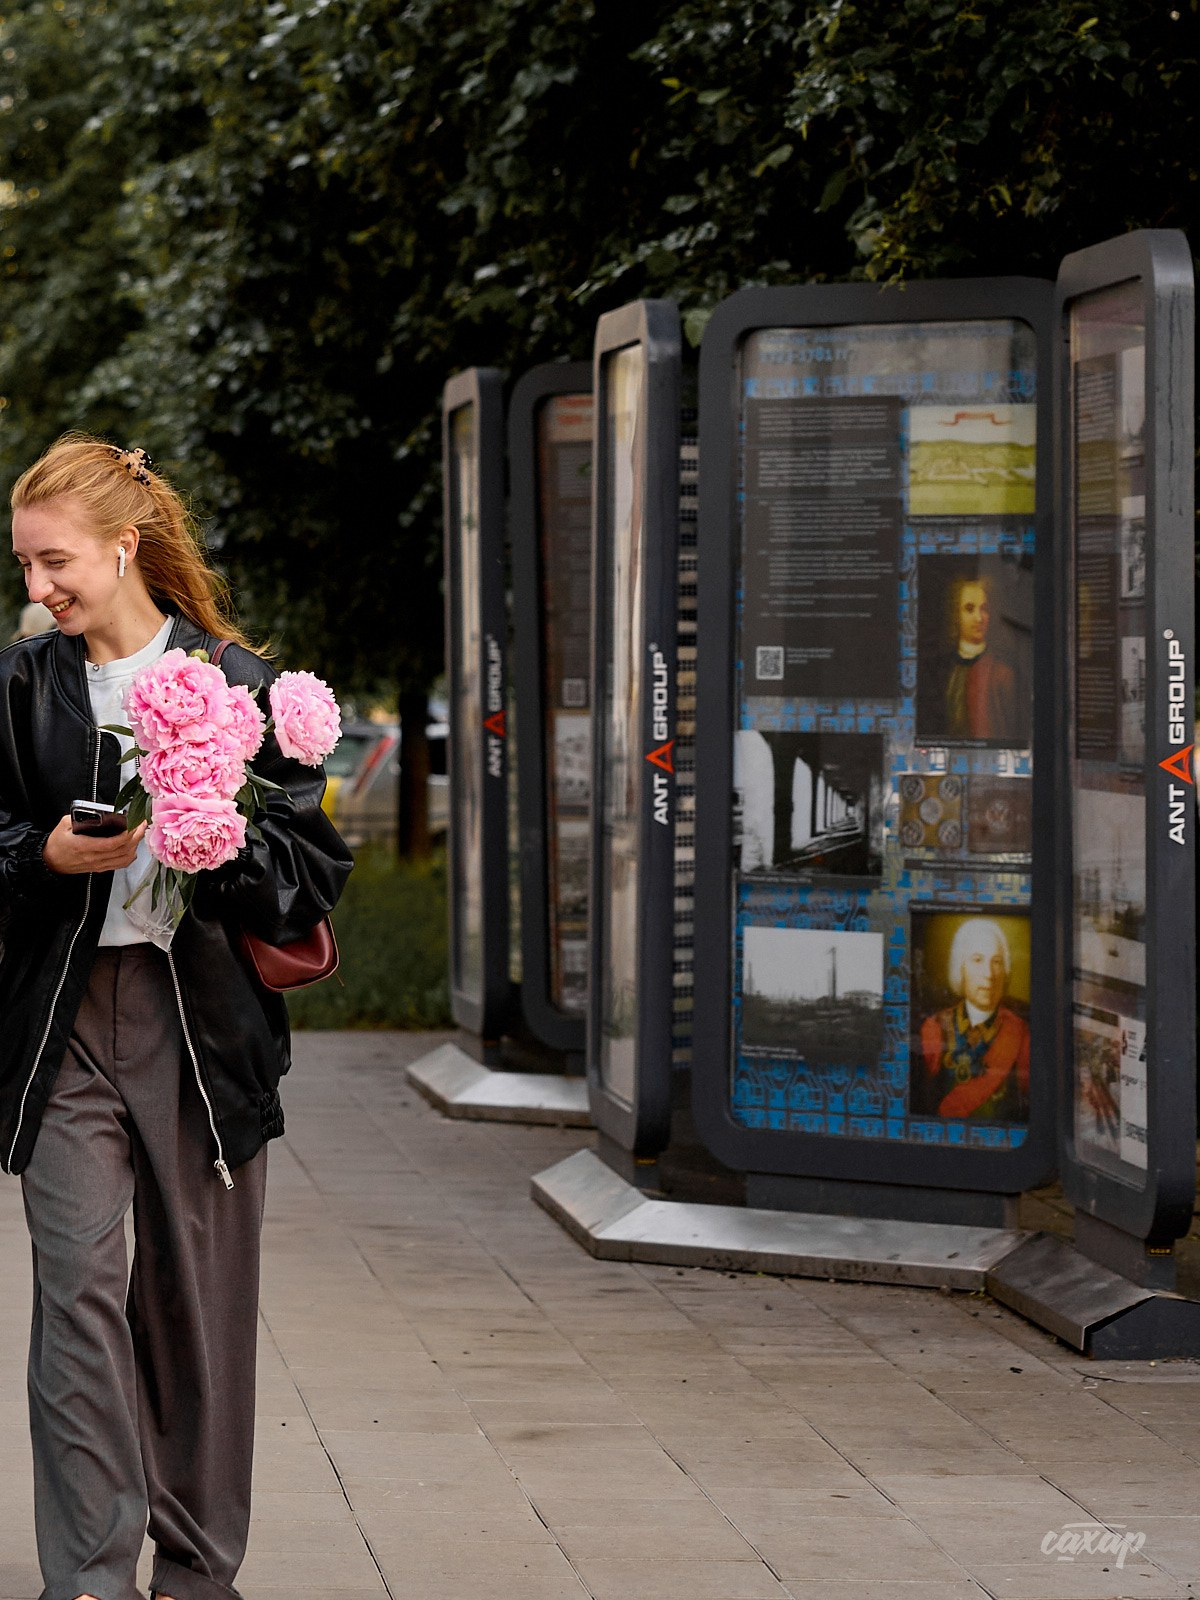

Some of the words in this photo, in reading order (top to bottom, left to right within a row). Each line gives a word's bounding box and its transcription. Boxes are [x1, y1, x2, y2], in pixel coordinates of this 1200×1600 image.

[488, 735, 502, 778] ANT
[653, 773, 669, 825] ANT
[1169, 784, 1185, 845] ANT
